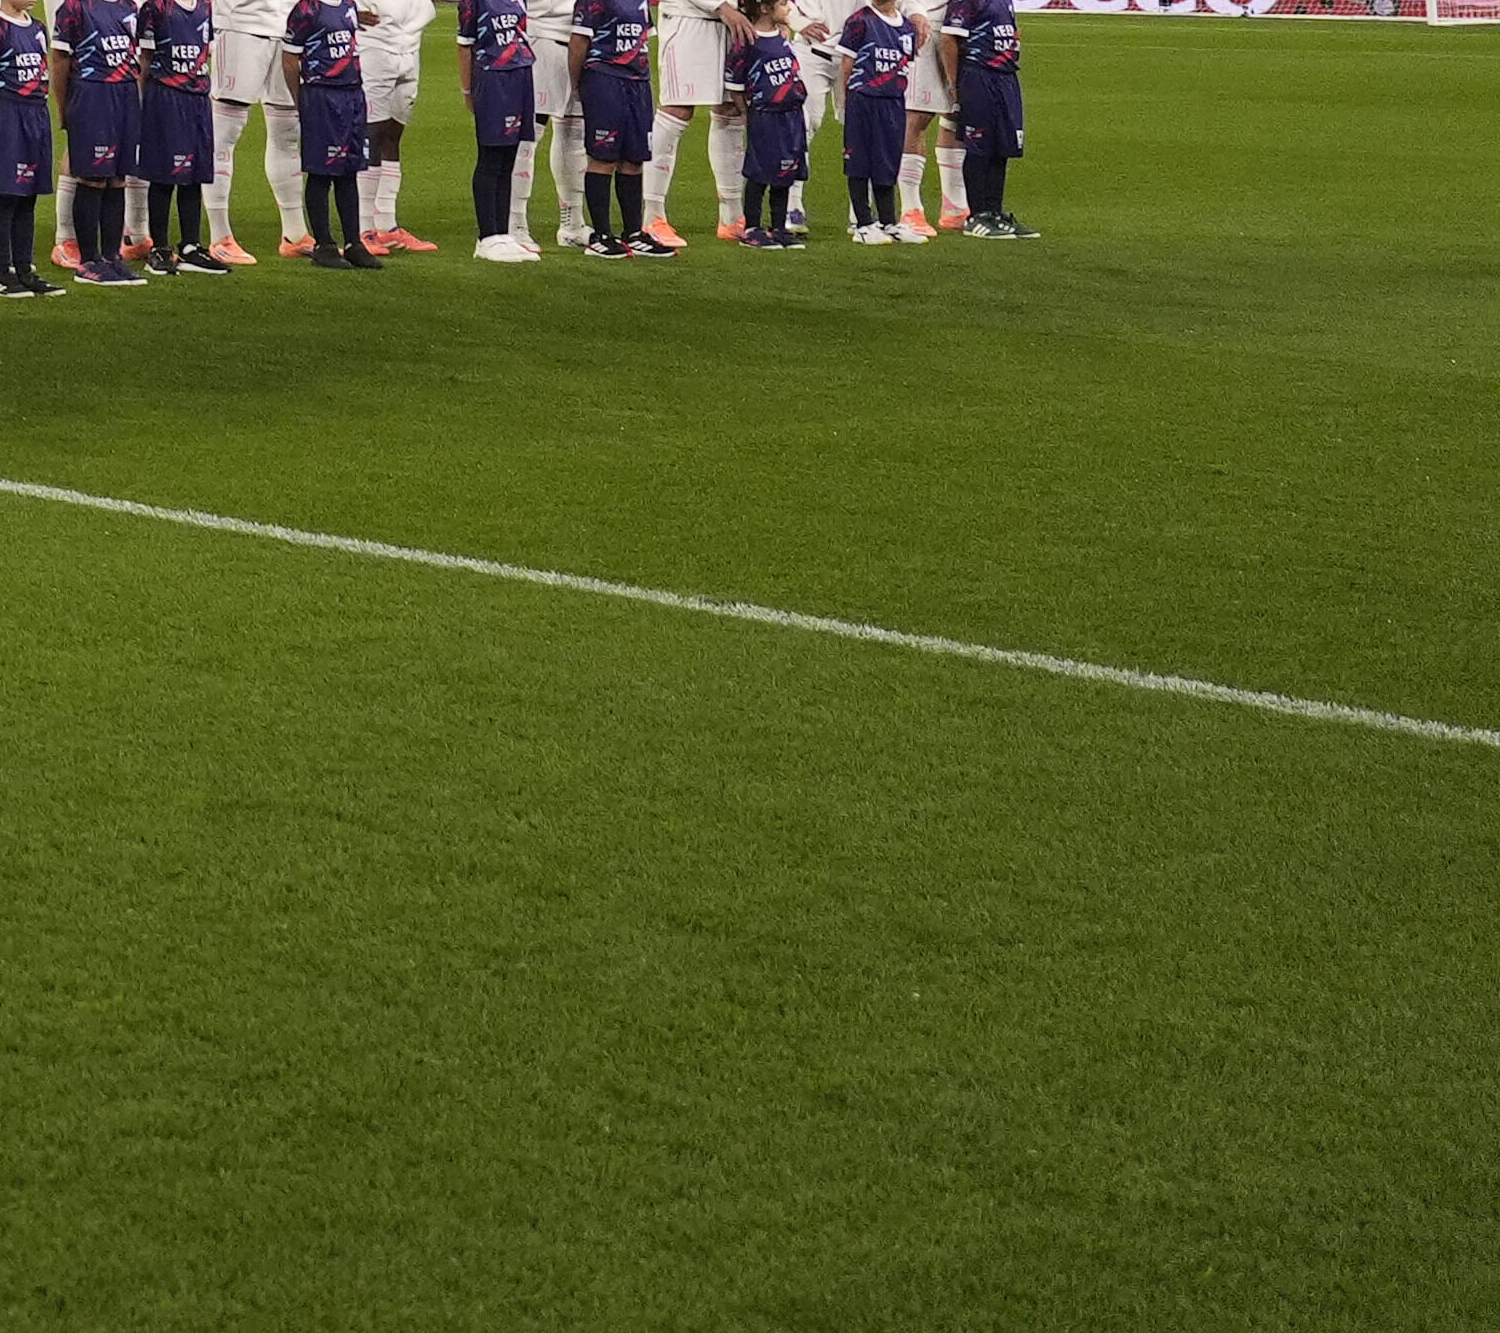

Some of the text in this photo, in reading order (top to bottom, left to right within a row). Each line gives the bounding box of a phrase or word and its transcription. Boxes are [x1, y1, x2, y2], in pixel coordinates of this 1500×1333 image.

[491, 14, 519, 30] KEEP
[327, 30, 352, 44] KEEP
[616, 23, 643, 37] KEEP
[100, 35, 131, 50] KEEP
[15, 53, 42, 67] KEEP
[171, 45, 201, 61] KEEP
[874, 47, 902, 61] KEEP
[764, 56, 793, 74] KEEP
